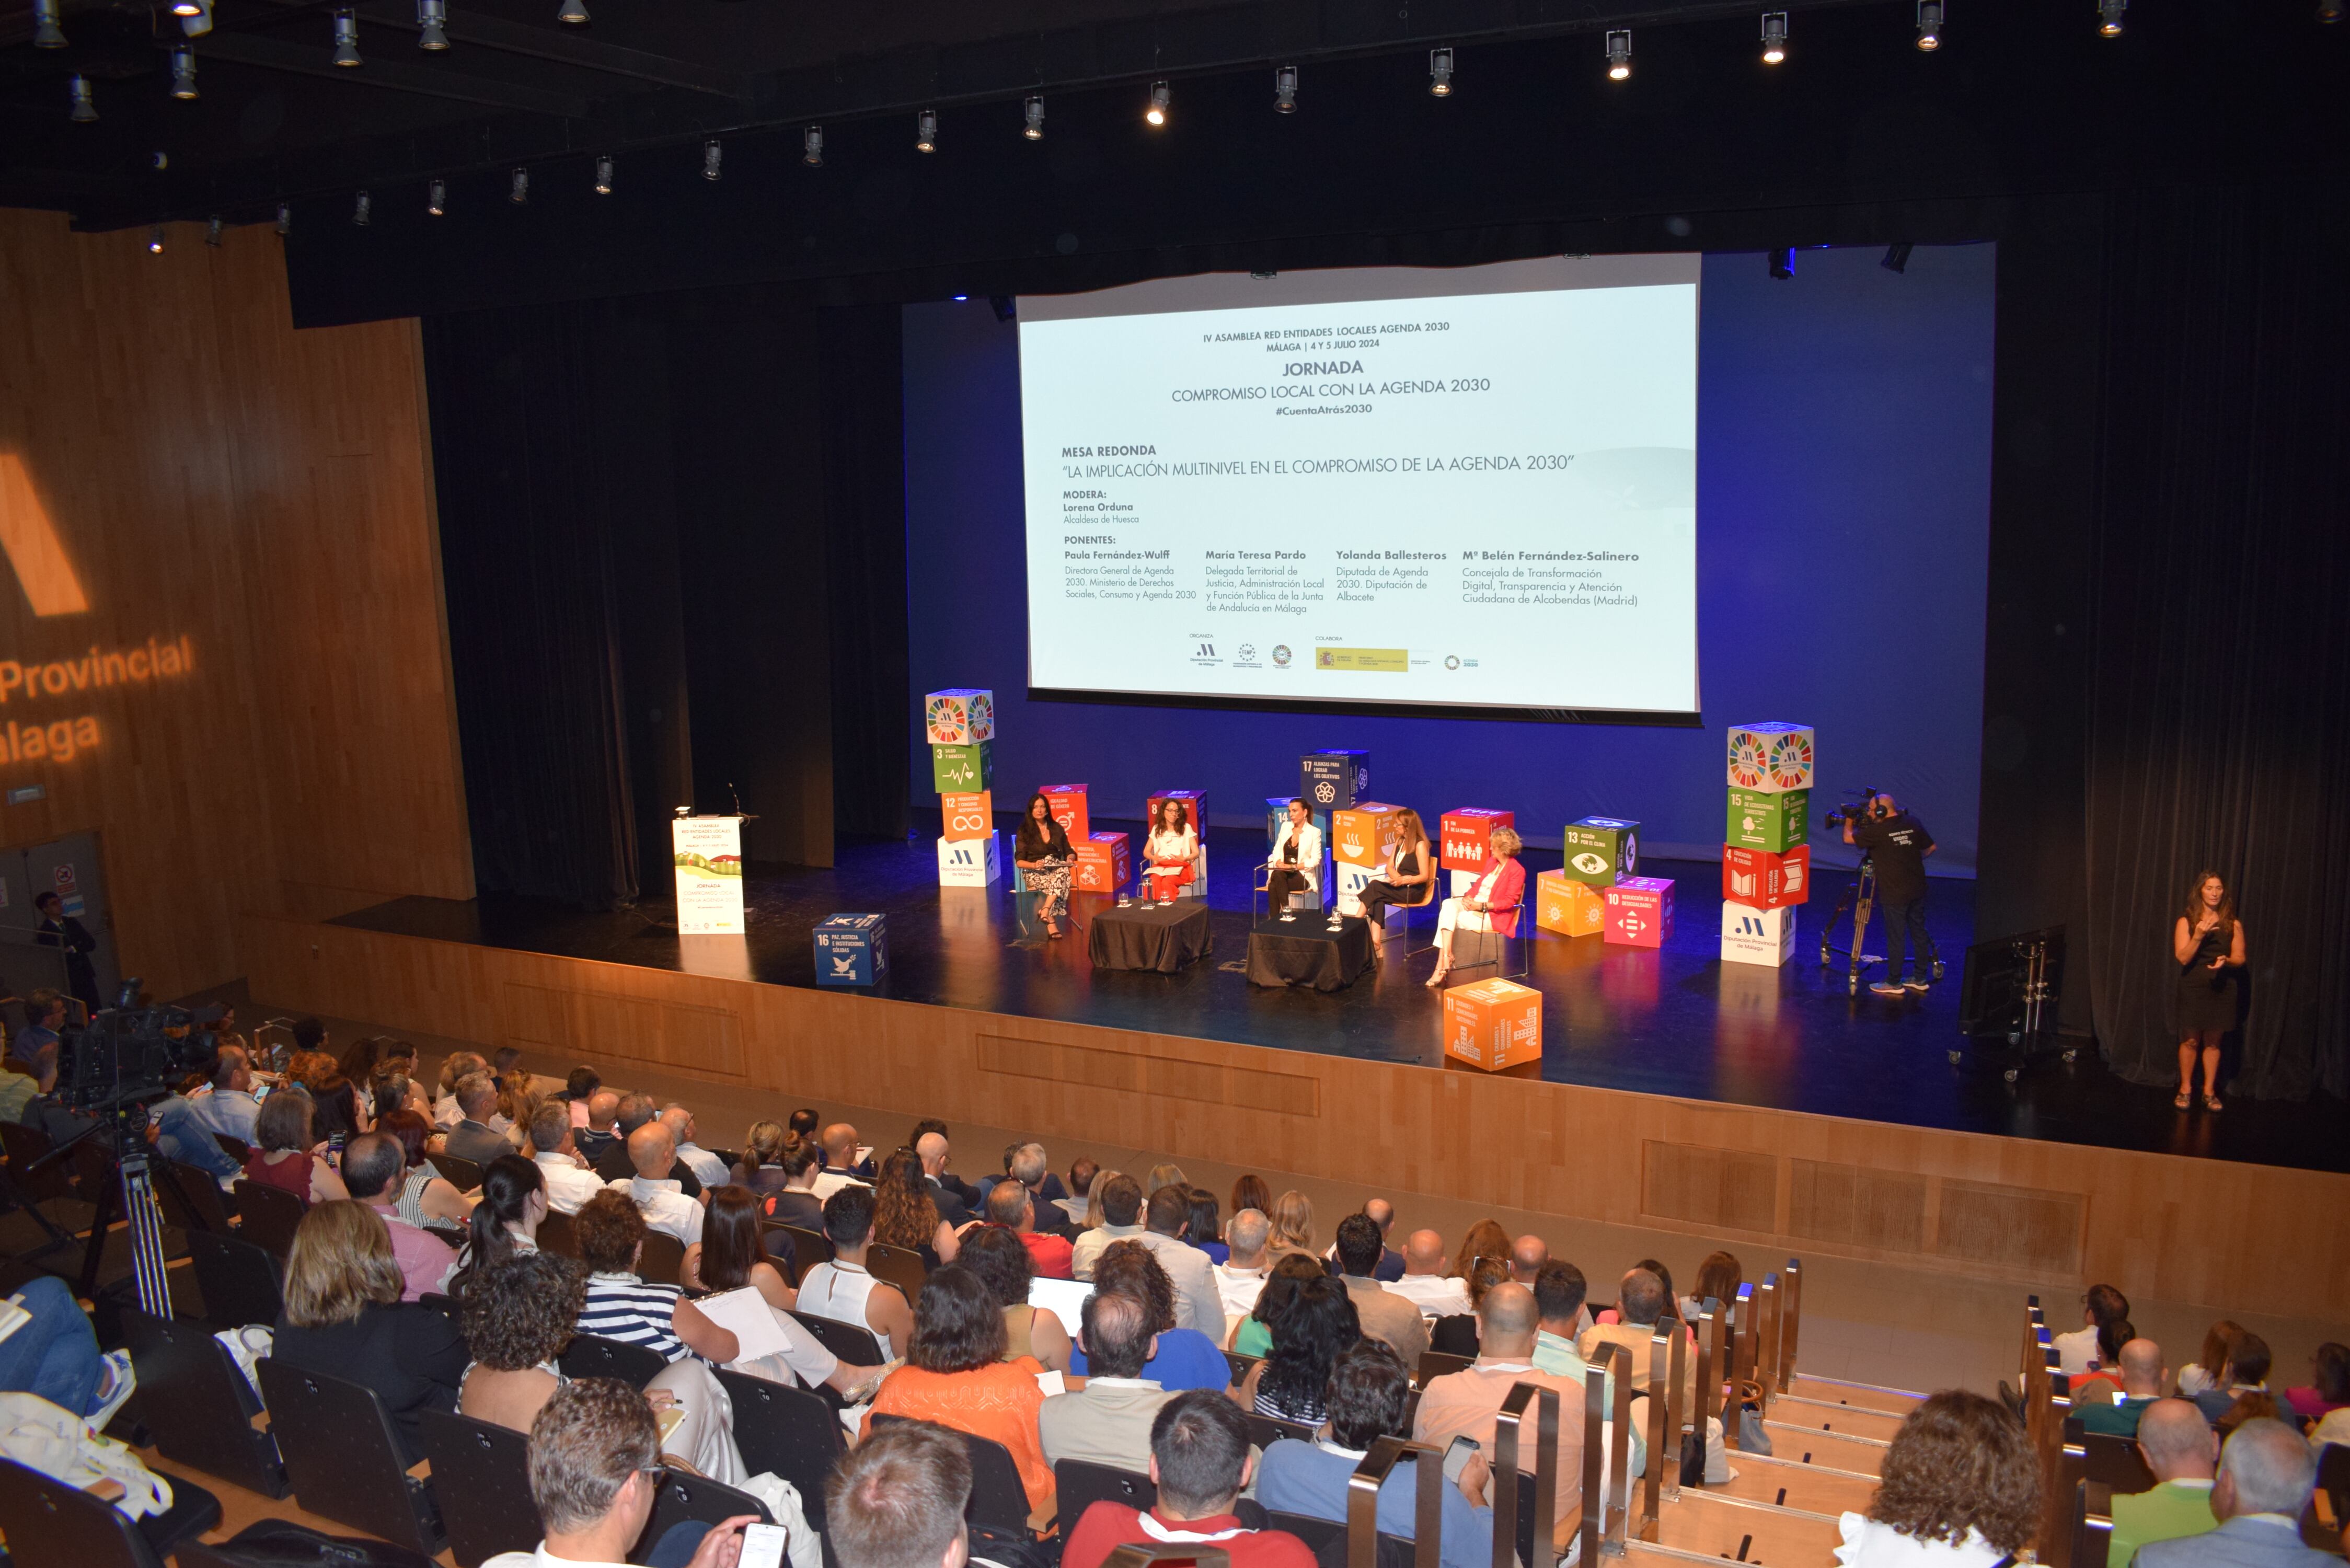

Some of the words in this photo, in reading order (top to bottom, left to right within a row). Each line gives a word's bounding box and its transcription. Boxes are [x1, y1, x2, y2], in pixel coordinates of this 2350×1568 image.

[1203, 334, 1212, 343] IV
[1215, 331, 1262, 342] ASAMBLEA
[1264, 330, 1281, 339] RED
[1283, 327, 1333, 338] ENTIDADES
[1337, 325, 1377, 336] LOCALES
[1379, 323, 1422, 334] AGENDA
[1424, 321, 1450, 331] 2030
[1266, 342, 1301, 352] MÁLAGA
[1310, 342, 1316, 350] 4
[1318, 341, 1324, 350] Y
[1326, 341, 1331, 350] 5
[1333, 340, 1356, 349] JULIO
[1358, 339, 1380, 348] 2024
[1282, 360, 1364, 377] JORNADA
[1171, 386, 1267, 402] COMPROMISO
[1271, 385, 1315, 399] LOCAL
[1318, 383, 1354, 397] CON
[1359, 382, 1376, 395] LA
[1379, 379, 1446, 395] AGENDA
[1450, 378, 1491, 392] 2030
[1275, 403, 1373, 416] #CuentaAtrás2030
[1062, 446, 1093, 458] MESA
[1097, 445, 1157, 457] REDONDA
[1063, 465, 1082, 478] “LA
[1086, 459, 1168, 478] IMPLICACIÓN
[1172, 461, 1247, 476] MULTINIVEL
[1250, 460, 1270, 475] EN
[1274, 460, 1288, 474] EL
[1292, 458, 1398, 474] COMPROMISO
[1402, 457, 1421, 472] DE
[1426, 457, 1445, 471] LA
[1448, 456, 1521, 471] AGENDA
[1527, 455, 1575, 470] 2030”
[1063, 490, 1107, 499] MODERA:
[1063, 503, 1095, 512] Lorena
[1097, 502, 1133, 512] Orduna
[1063, 514, 1099, 524] Alcaldesa
[1100, 513, 1111, 523] de
[1112, 514, 1139, 523] Huesca
[1064, 535, 1116, 545] PONENTES:
[1065, 550, 1090, 559] Paula
[1093, 549, 1170, 559] Fernández-Wulff
[1205, 550, 1235, 559] María
[1238, 550, 1271, 559] Teresa
[1275, 549, 1306, 560] Pardo
[1335, 550, 1381, 560] Yolanda
[1385, 550, 1447, 560] Ballesteros
[1462, 551, 1478, 560] Mª
[1482, 550, 1515, 560] Belén
[1518, 550, 1640, 561] Fernández-Salinero
[1065, 566, 1098, 574] Directora
[1100, 564, 1130, 575] General
[1131, 564, 1142, 574] de
[1144, 564, 1174, 579] Agenda
[1205, 564, 1244, 578] Delegada
[1246, 565, 1285, 575] Territorial
[1287, 565, 1298, 575] de
[1336, 566, 1376, 579] Diputada
[1378, 566, 1390, 576] de
[1392, 566, 1429, 579] Agenda
[1462, 566, 1509, 580] Concejala
[1512, 567, 1525, 578] de
[1527, 567, 1602, 578] Transformación
[1065, 578, 1087, 586] 2030.
[1089, 578, 1126, 586] Ministerio
[1127, 577, 1137, 587] de
[1139, 577, 1174, 587] Derechos
[1205, 578, 1237, 589] Justicia,
[1239, 578, 1300, 588] Administración
[1303, 578, 1324, 589] Local
[1337, 579, 1363, 589] 2030.
[1365, 579, 1413, 592] Diputación
[1415, 579, 1427, 589] de
[1462, 579, 1496, 593] Digital,
[1499, 581, 1566, 594] Transparencia
[1569, 585, 1575, 594] y
[1577, 582, 1622, 592] Atención
[1066, 589, 1097, 599] Sociales,
[1099, 590, 1134, 598] Consumo
[1135, 593, 1141, 602] y
[1142, 589, 1173, 602] Agenda
[1175, 590, 1196, 599] 2030
[1206, 593, 1212, 604] y
[1213, 590, 1245, 600] Función
[1247, 590, 1276, 600] Pública
[1278, 590, 1290, 600] de
[1291, 590, 1299, 601] la
[1301, 591, 1323, 601] Junta
[1336, 591, 1375, 602] Albacete
[1462, 593, 1515, 604] Ciudadana
[1518, 593, 1530, 604] de
[1533, 593, 1591, 605] Alcobendas
[1594, 594, 1638, 607] (Madrid)
[1206, 602, 1217, 612] de
[1218, 602, 1260, 612] Andalucía
[1274, 602, 1307, 616] Málaga
[0, 634, 192, 703] Provincial
[937, 749, 942, 758] 3
[1303, 761, 1312, 772] 17
[946, 798, 955, 808] 12
[1731, 794, 1741, 806] 15
[1151, 804, 1157, 814] 8
[1277, 812, 1288, 823] 14
[1336, 814, 1341, 825] 2
[1444, 821, 1448, 831] 1
[1568, 832, 1578, 843] 13
[1726, 849, 1732, 860] 4
[1734, 850, 1752, 859] EDUCACIÓN
[1608, 893, 1619, 905] 10
[817, 934, 829, 946] 16
[1446, 997, 1454, 1011] 11
